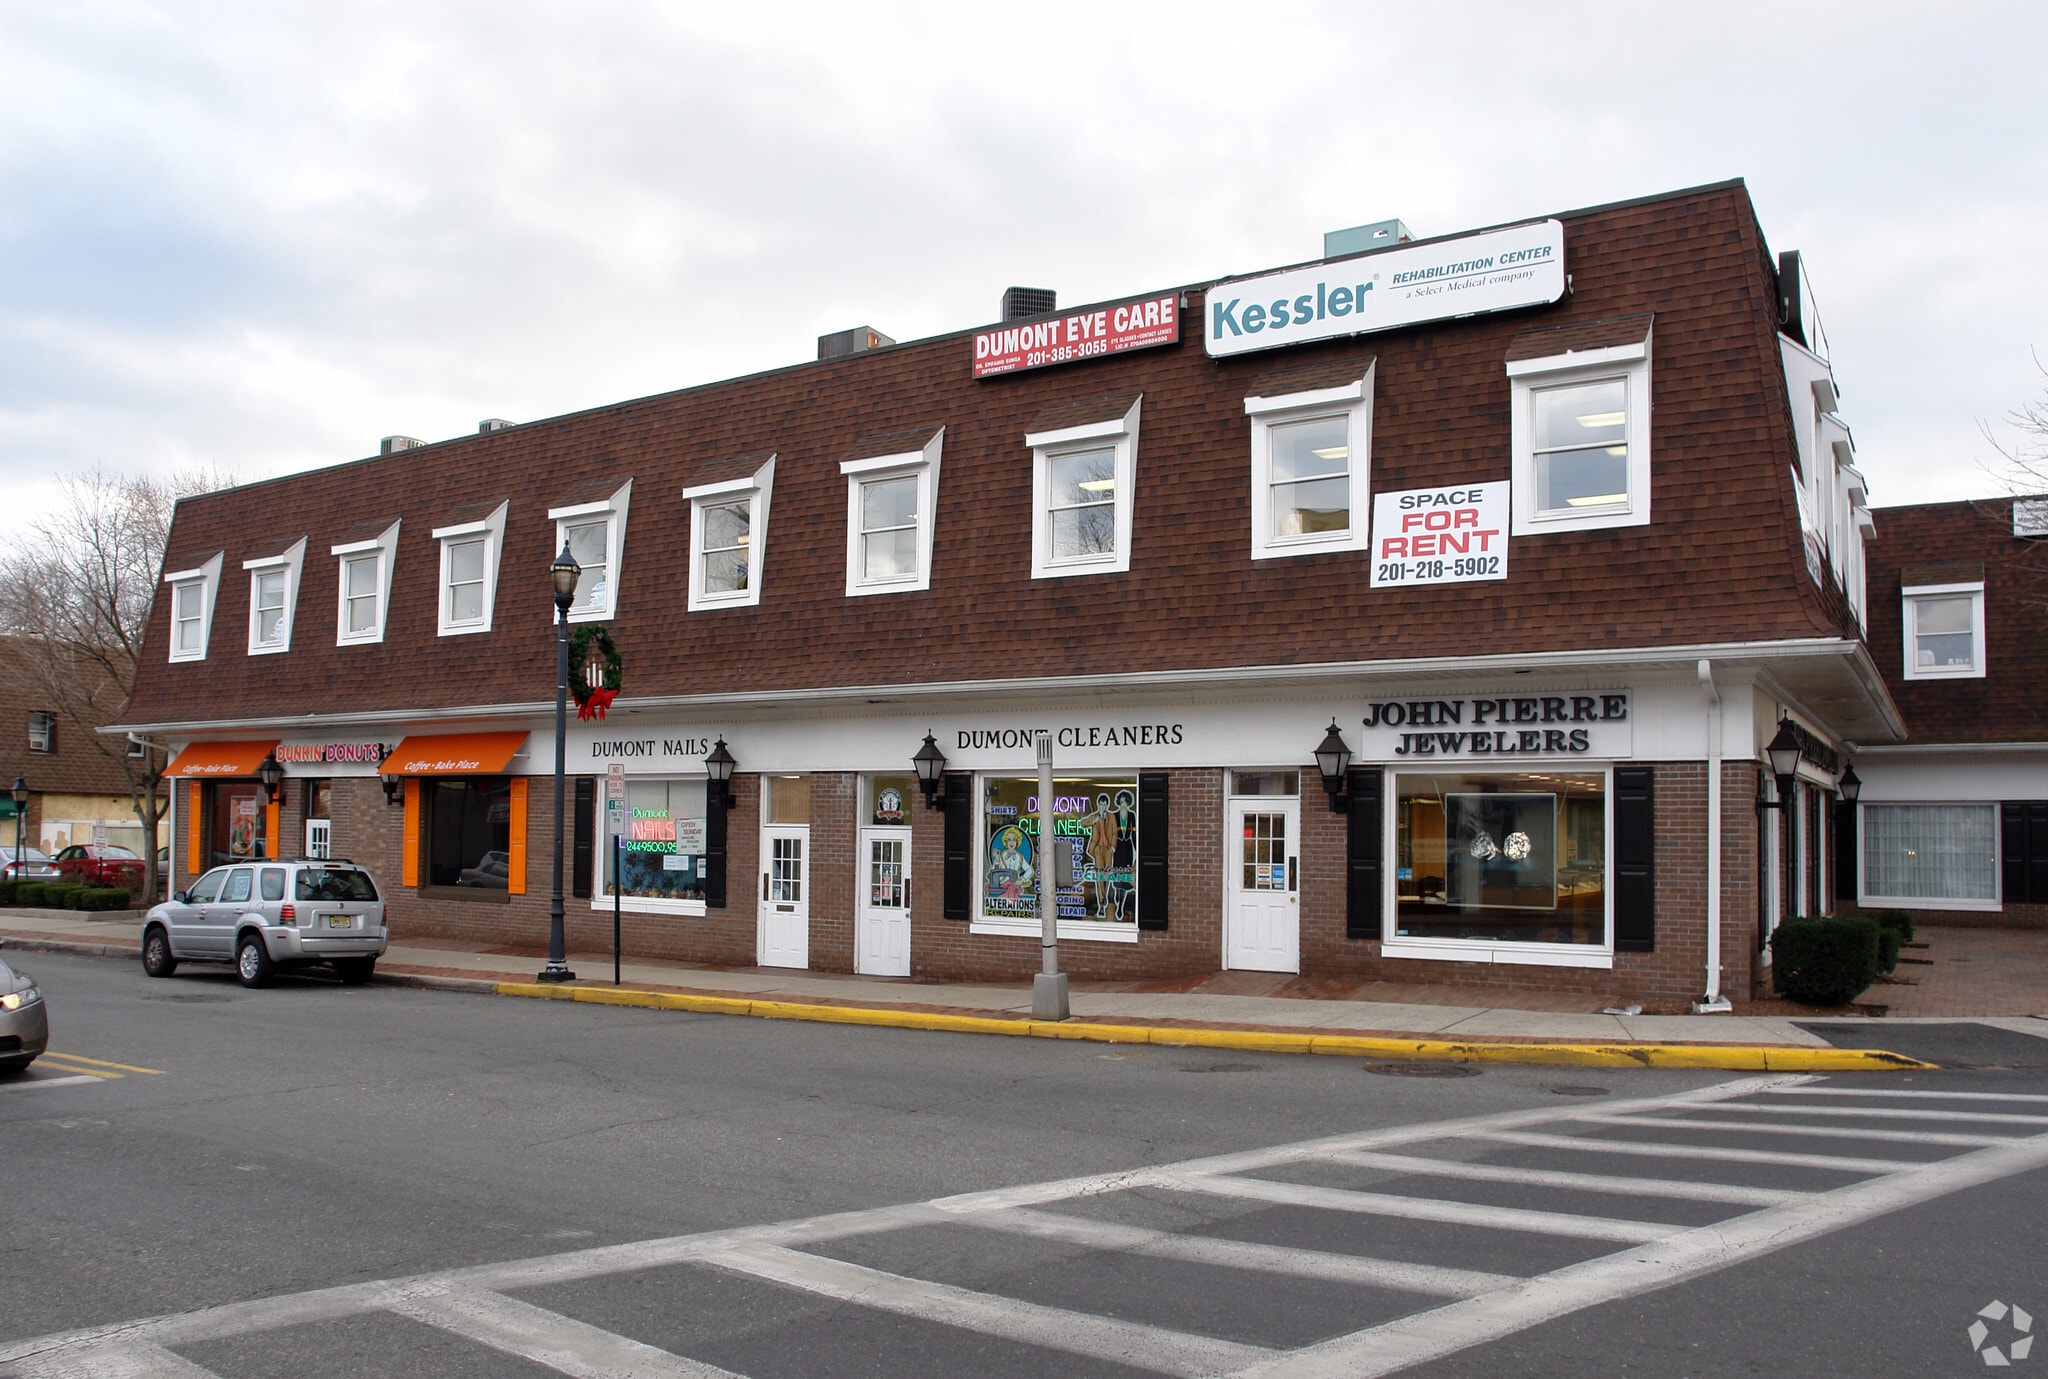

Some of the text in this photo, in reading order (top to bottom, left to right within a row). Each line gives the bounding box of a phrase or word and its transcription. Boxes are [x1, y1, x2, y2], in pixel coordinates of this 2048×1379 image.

[1392, 245, 1552, 285] REHABILITATION CENTER
[1406, 268, 1536, 299] a Select Medical company
[1212, 281, 1374, 340] Kessler
[976, 297, 1174, 359] DUMONT EYE CARE
[1027, 339, 1107, 366] 201-385-3055
[1399, 489, 1483, 509] SPACE
[1402, 508, 1479, 533] FOR
[1381, 529, 1499, 559] RENT
[1377, 556, 1499, 581] 201-218-5902
[1362, 694, 1628, 727] JOHN PIERRE
[1058, 724, 1184, 747] CLEANERS
[1394, 728, 1591, 755] JEWELERS
[275, 743, 380, 763] DUNKIN' DONUTS
[592, 738, 709, 757] DUMONT NAILS
[182, 763, 239, 773] Coffee Bake Place
[403, 759, 480, 773] Coffee Bake Place
[632, 807, 668, 818] Dumont
[990, 806, 1016, 814] SHIRTS
[632, 820, 676, 841] NAILS
[681, 821, 696, 829] OPEN
[985, 897, 1035, 910] ALTERATIONS
[1060, 906, 1086, 916] REPAIR
